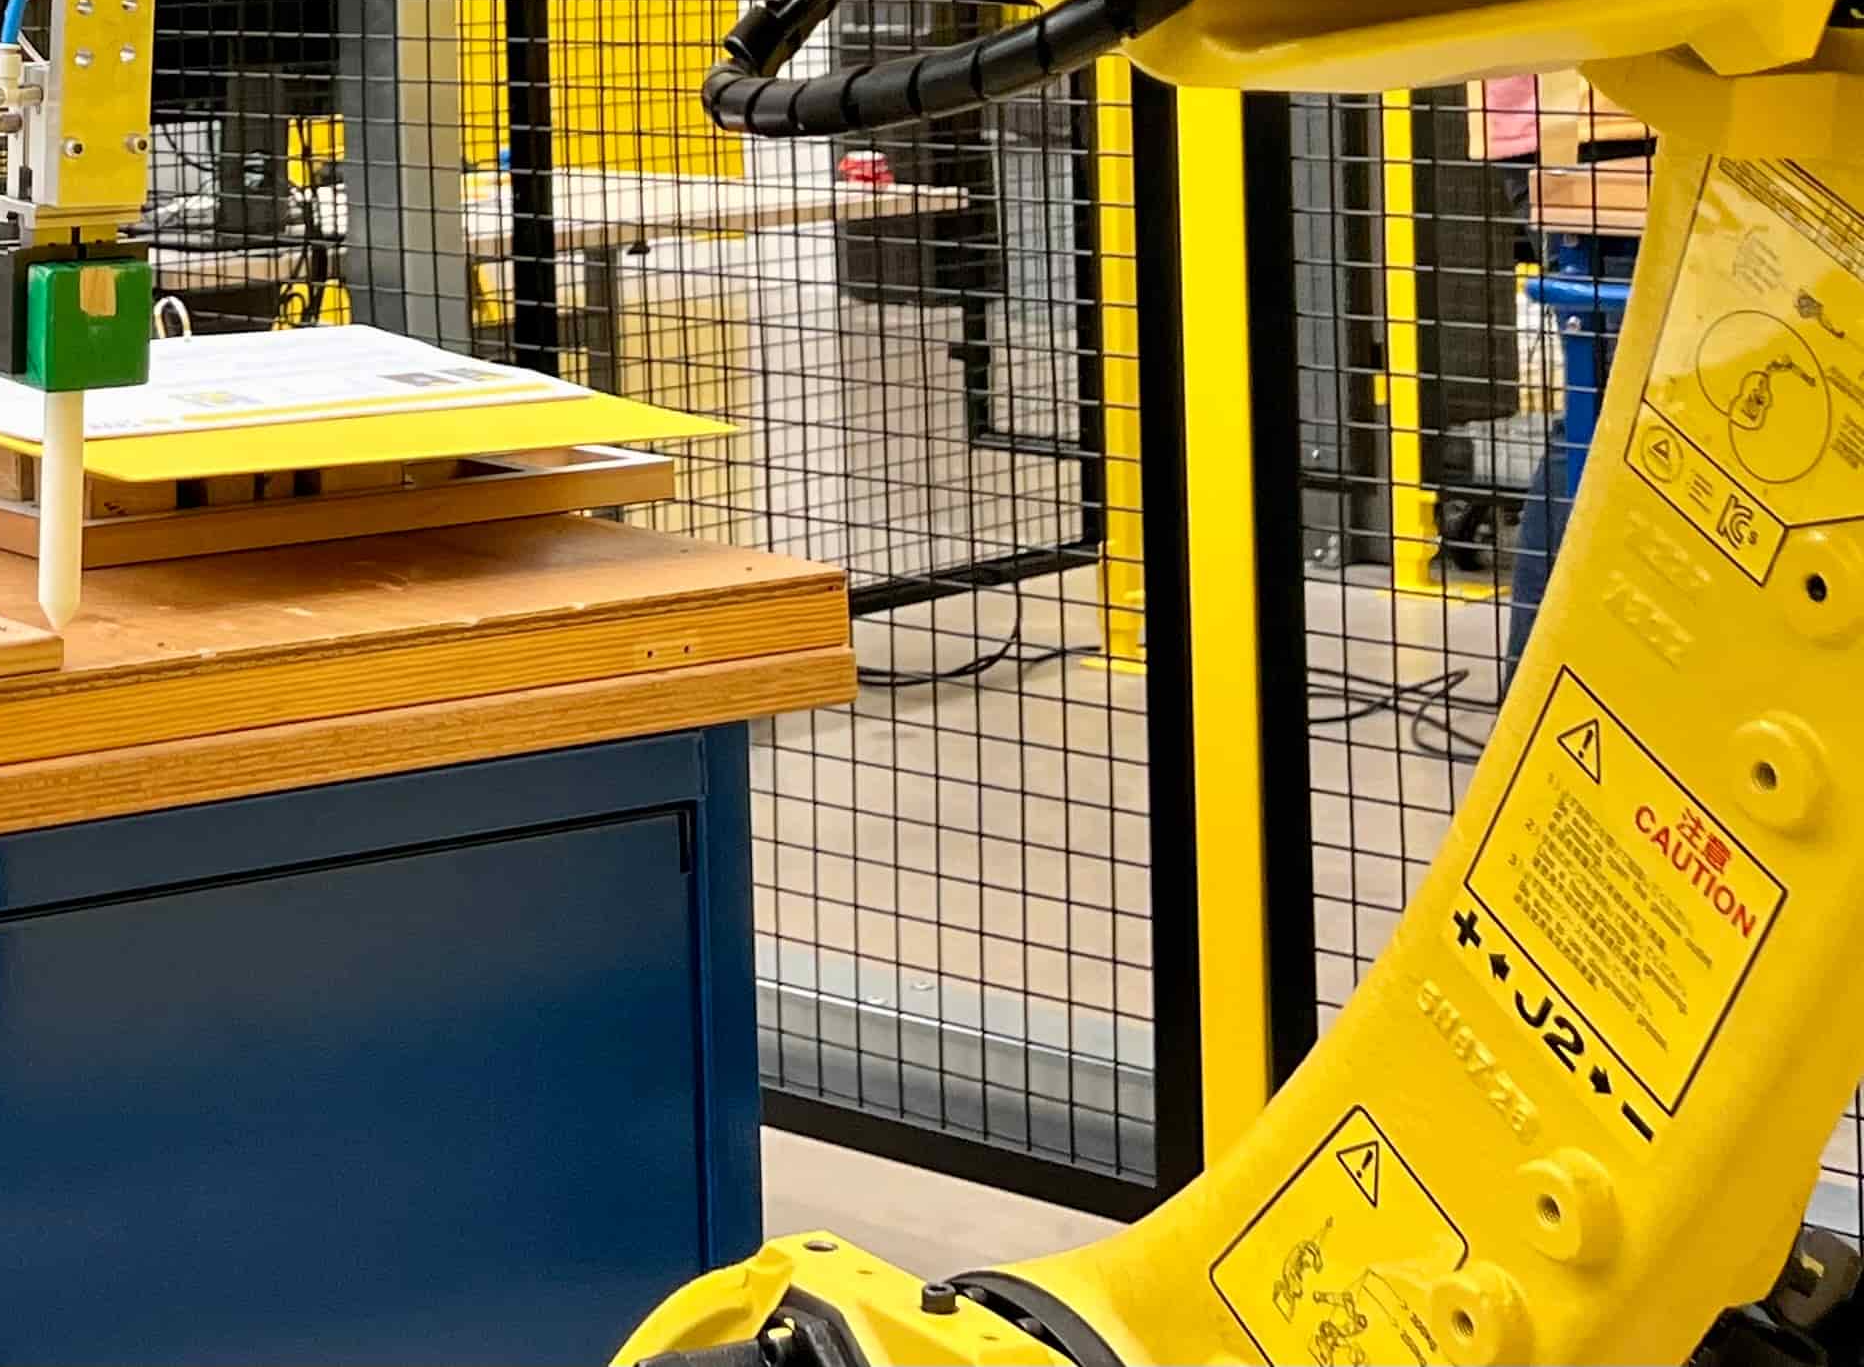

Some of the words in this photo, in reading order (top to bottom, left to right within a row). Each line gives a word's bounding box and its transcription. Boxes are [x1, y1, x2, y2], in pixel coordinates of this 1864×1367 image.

[1634, 805, 1756, 938] CAUTION
[1676, 806, 1733, 875] 注意
[1514, 991, 1586, 1073] J2
